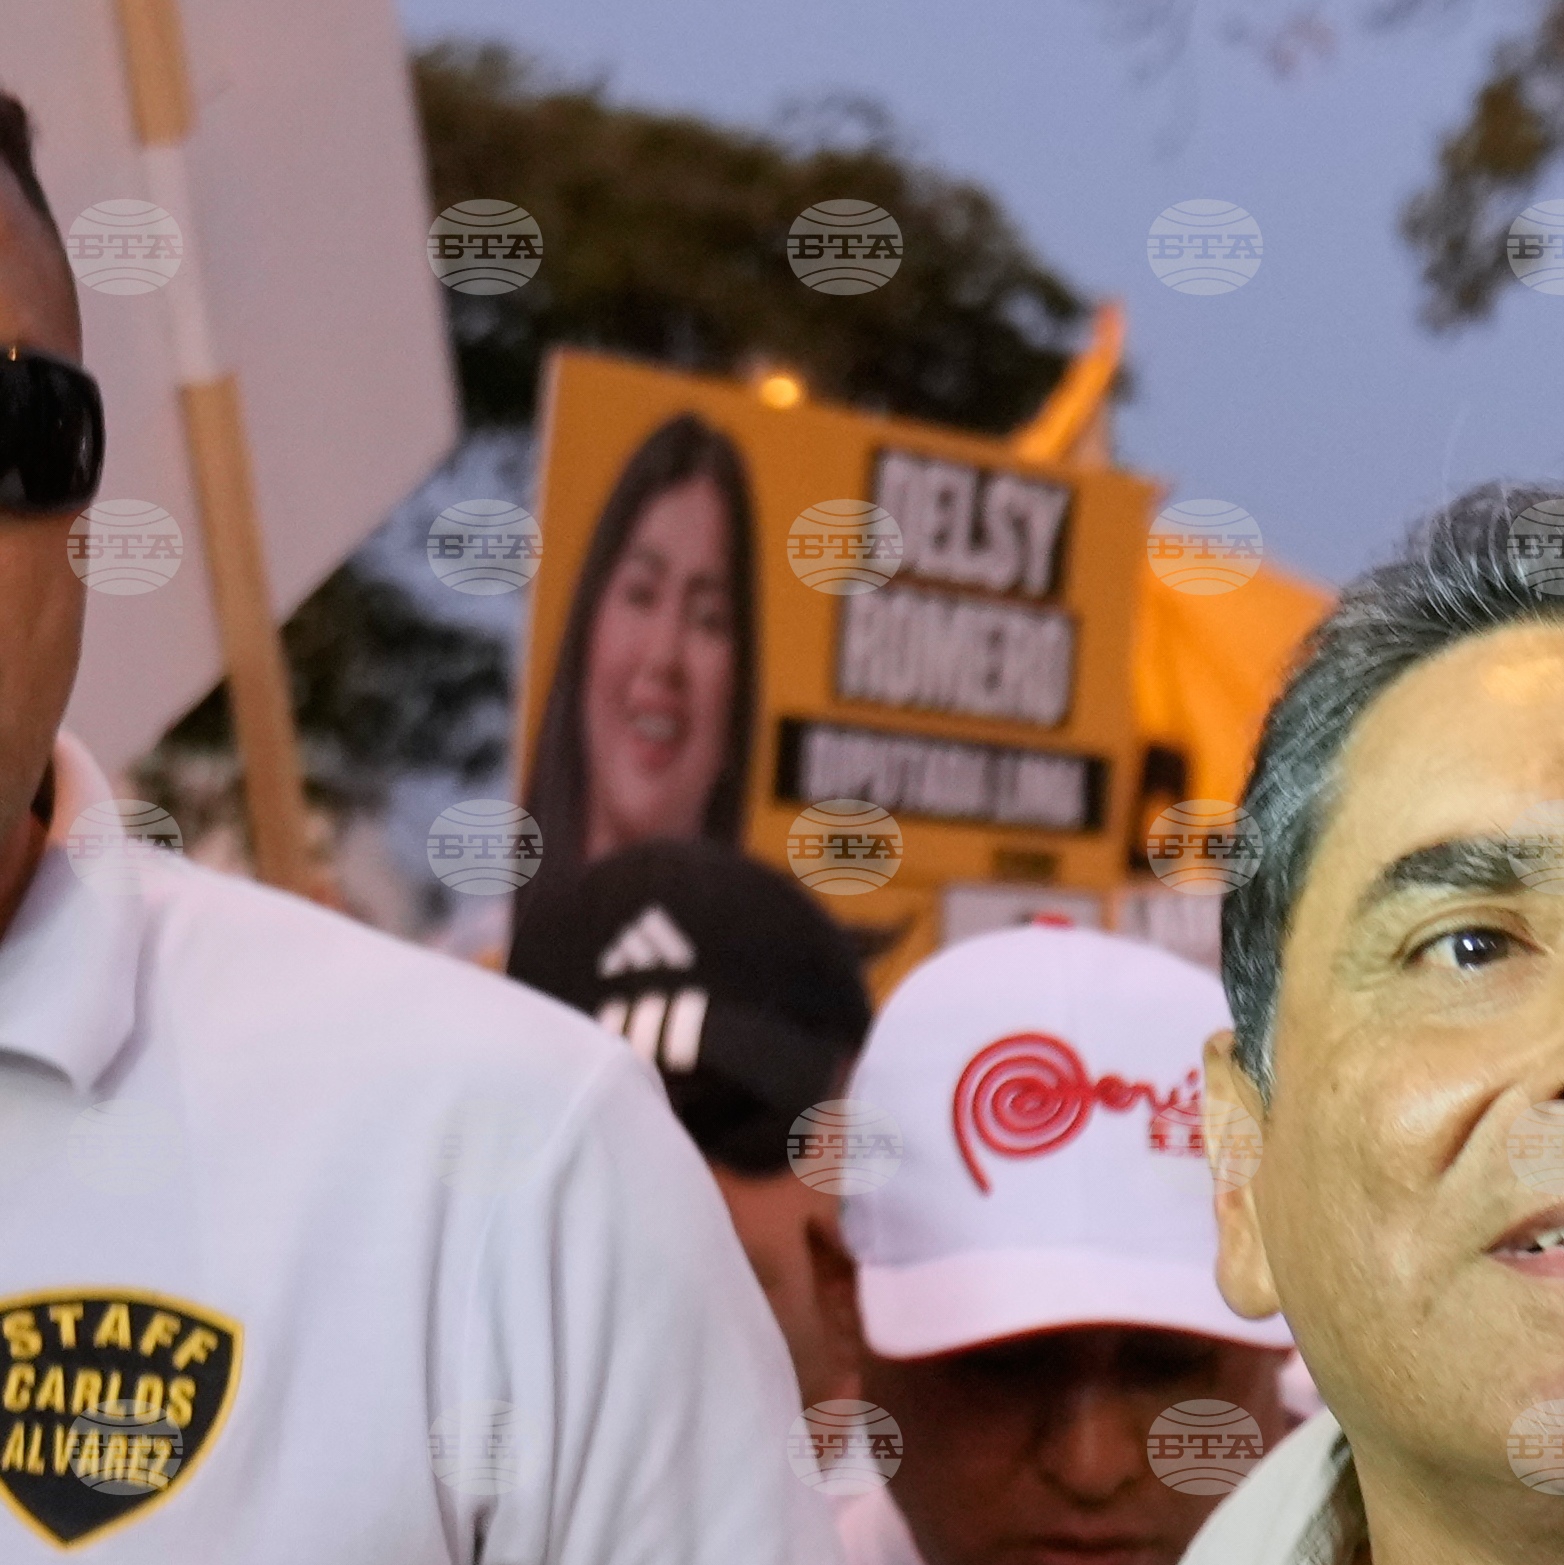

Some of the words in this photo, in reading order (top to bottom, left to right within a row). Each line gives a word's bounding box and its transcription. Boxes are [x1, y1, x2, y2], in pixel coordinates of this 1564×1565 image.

[2, 1302, 219, 1371] STAFF
[3, 1362, 197, 1428] CARLOS
[1, 1420, 173, 1487] ALVAREZ
